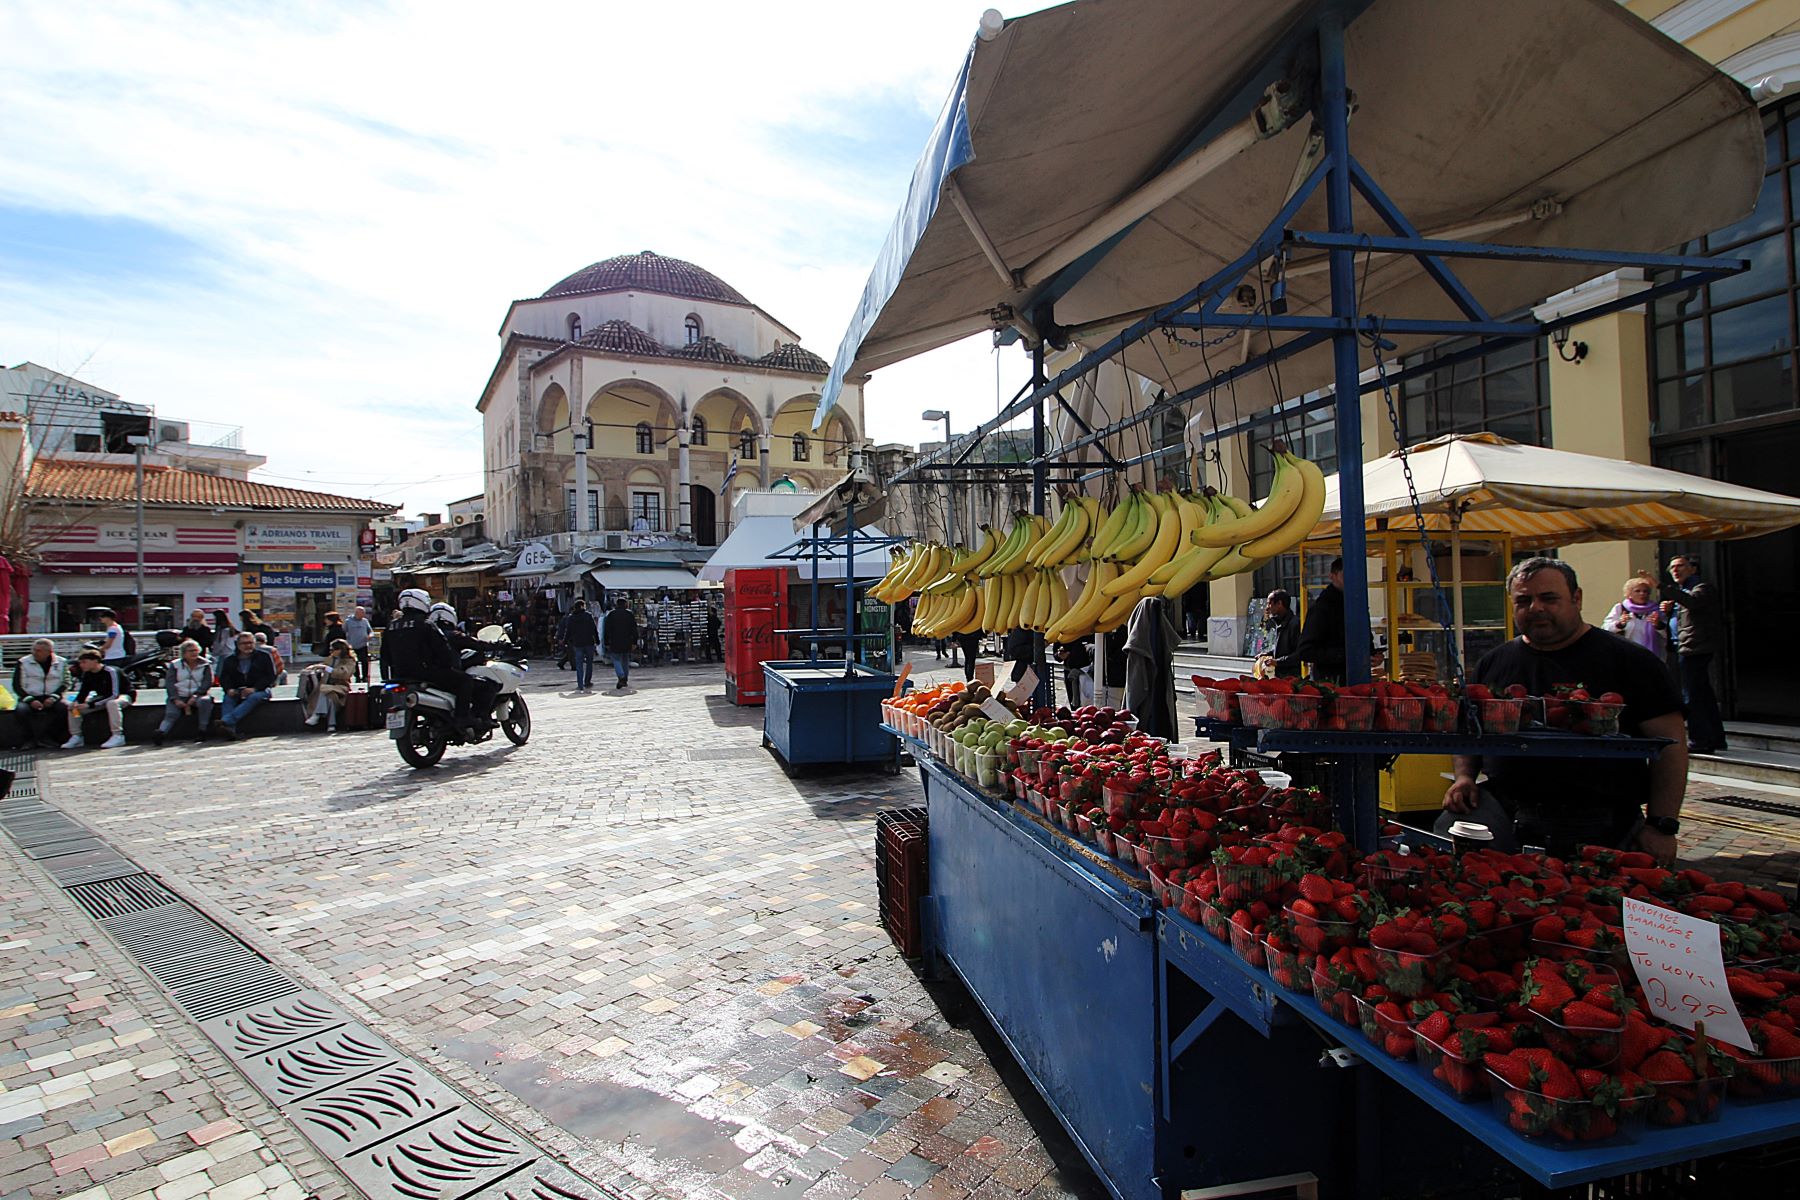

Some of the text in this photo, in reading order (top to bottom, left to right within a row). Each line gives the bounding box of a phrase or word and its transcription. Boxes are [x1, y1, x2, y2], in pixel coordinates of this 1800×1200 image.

[106, 530, 168, 538] ICE CEAM
[262, 530, 307, 538] ADRIANOS
[89, 566, 171, 575] gelato artiianale
[261, 576, 282, 584] Blue
[283, 576, 302, 584] Star
[303, 576, 334, 584] Ferries
